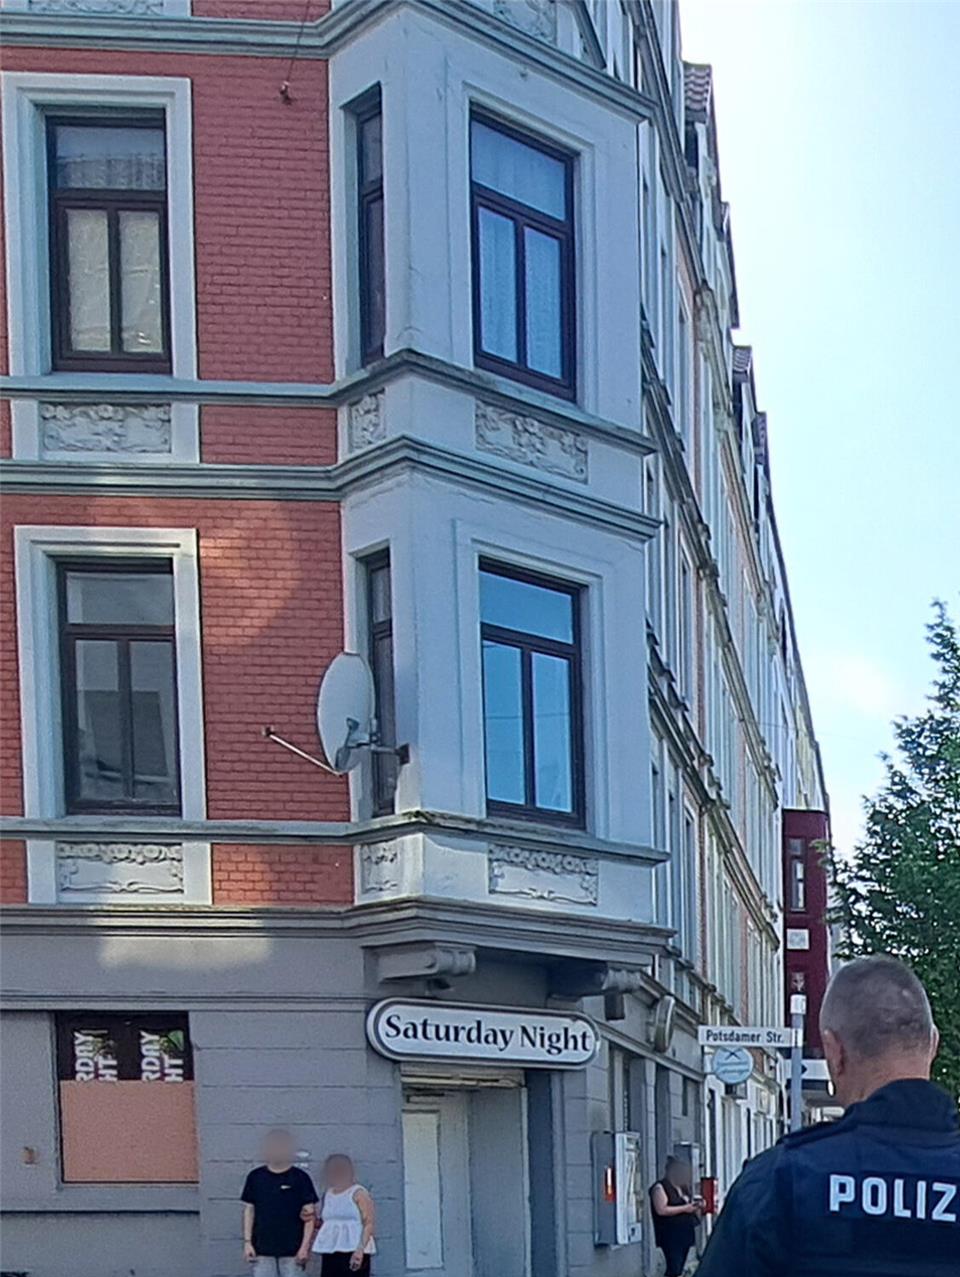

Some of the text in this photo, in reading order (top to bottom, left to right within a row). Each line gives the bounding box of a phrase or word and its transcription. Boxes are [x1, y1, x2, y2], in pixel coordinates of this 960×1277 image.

[385, 1014, 591, 1055] Saturday Night
[706, 1029, 784, 1043] Potsdamer Str.
